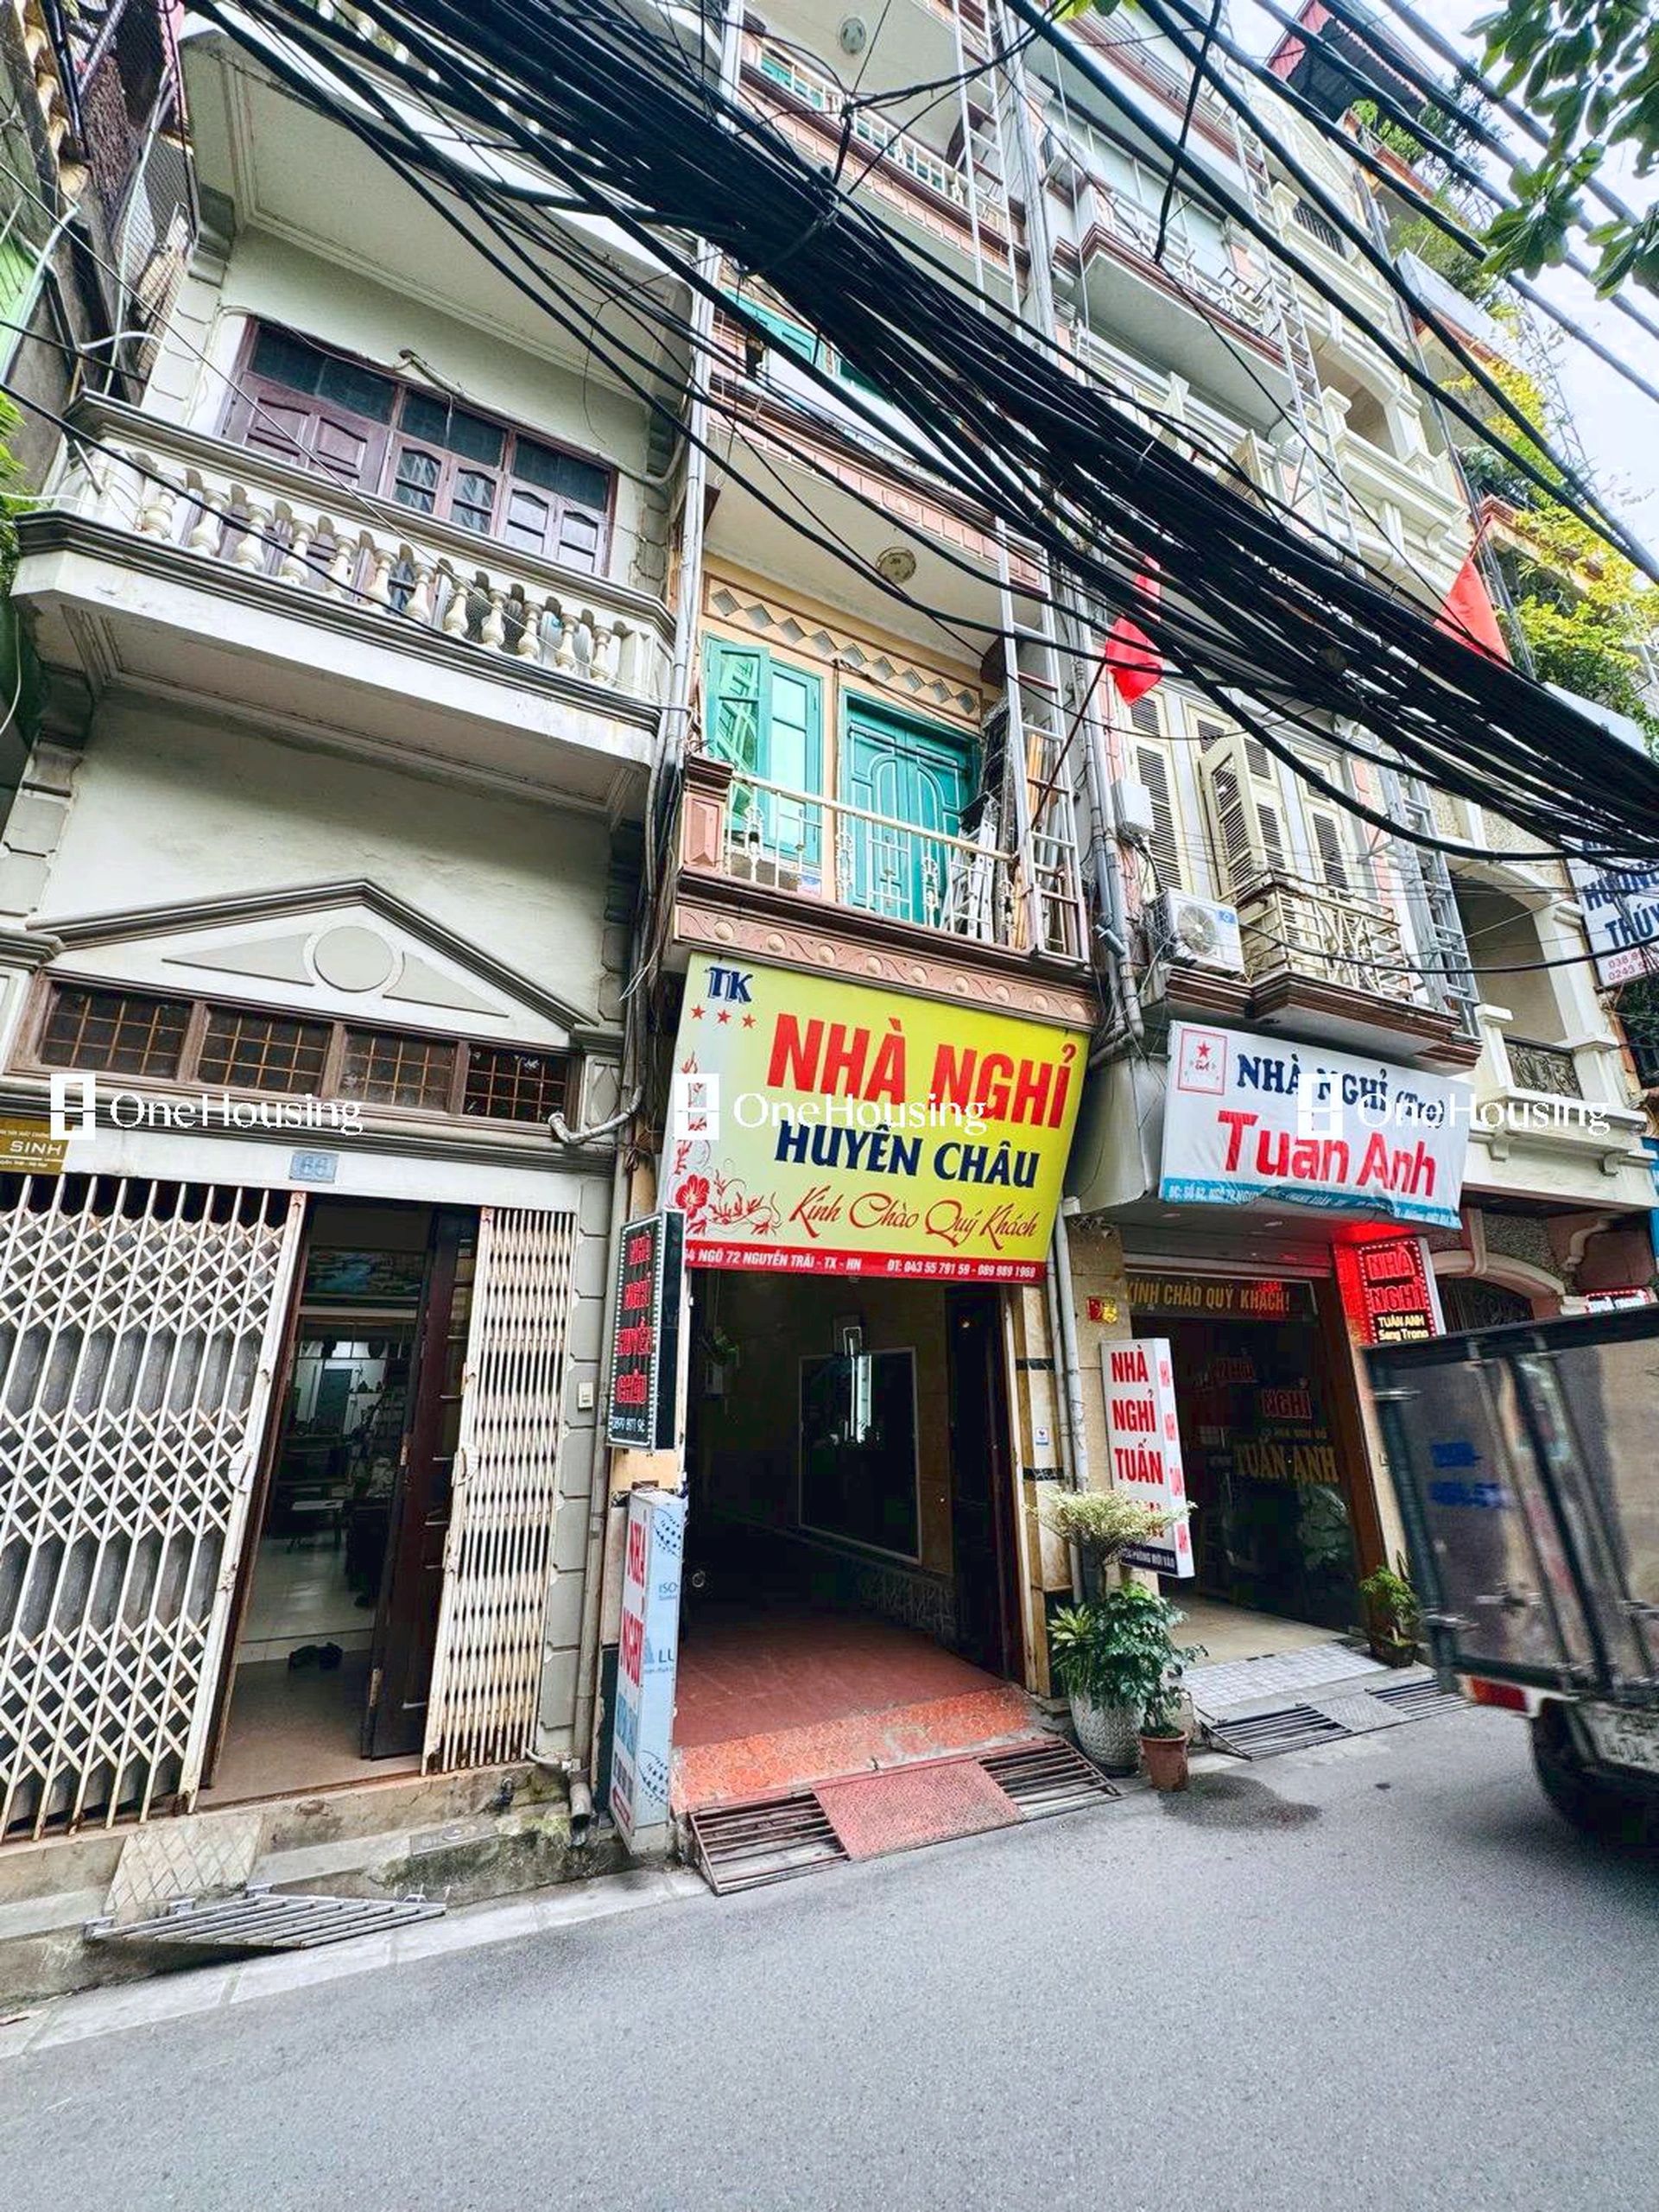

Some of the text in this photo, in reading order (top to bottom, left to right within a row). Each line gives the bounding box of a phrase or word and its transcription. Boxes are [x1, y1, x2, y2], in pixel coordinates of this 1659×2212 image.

[706, 966, 754, 1003] TK
[767, 1012, 1077, 1130] NHÀ NGHỈ
[1237, 1053, 1302, 1095] NHÀ
[9, 1139, 63, 1156] SINH
[934, 1139, 1041, 1188] CHÂU
[1356, 1131, 1436, 1198] Anh
[788, 1184, 1040, 1251] Kính Chào Quý Khách
[726, 1251, 743, 1264] 72
[824, 1257, 837, 1271] TX
[1366, 1245, 1416, 1280] NHÀ
[1368, 1276, 1426, 1313] NGHỈ
[1111, 1344, 1149, 1383] NHÀ
[1111, 1388, 1156, 1433] NGHỈ
[1114, 1437, 1164, 1485] TUẤN
